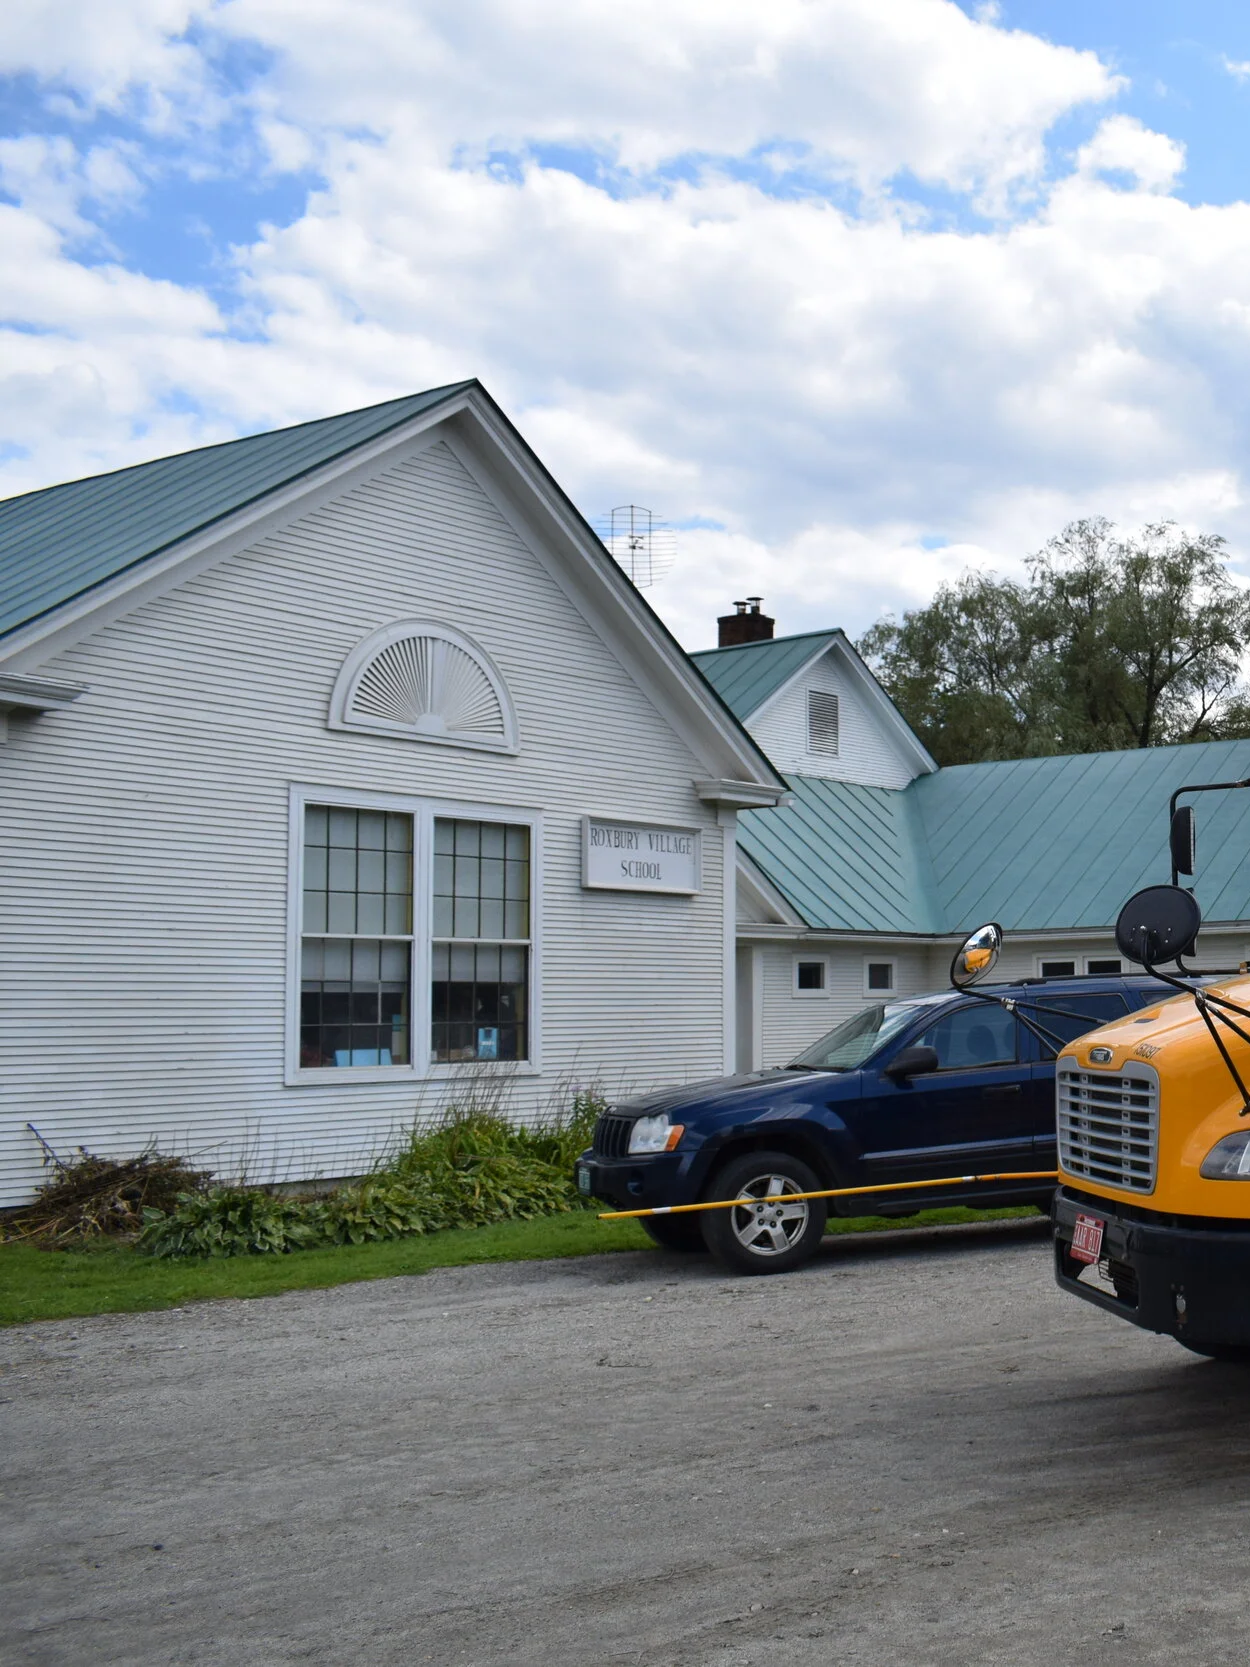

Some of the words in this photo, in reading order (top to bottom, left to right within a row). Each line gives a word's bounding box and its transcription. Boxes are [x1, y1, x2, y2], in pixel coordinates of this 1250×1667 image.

[590, 827, 640, 850] ROXBURY
[648, 833, 692, 855] VILLAGE
[621, 860, 661, 880] SCHOOL
